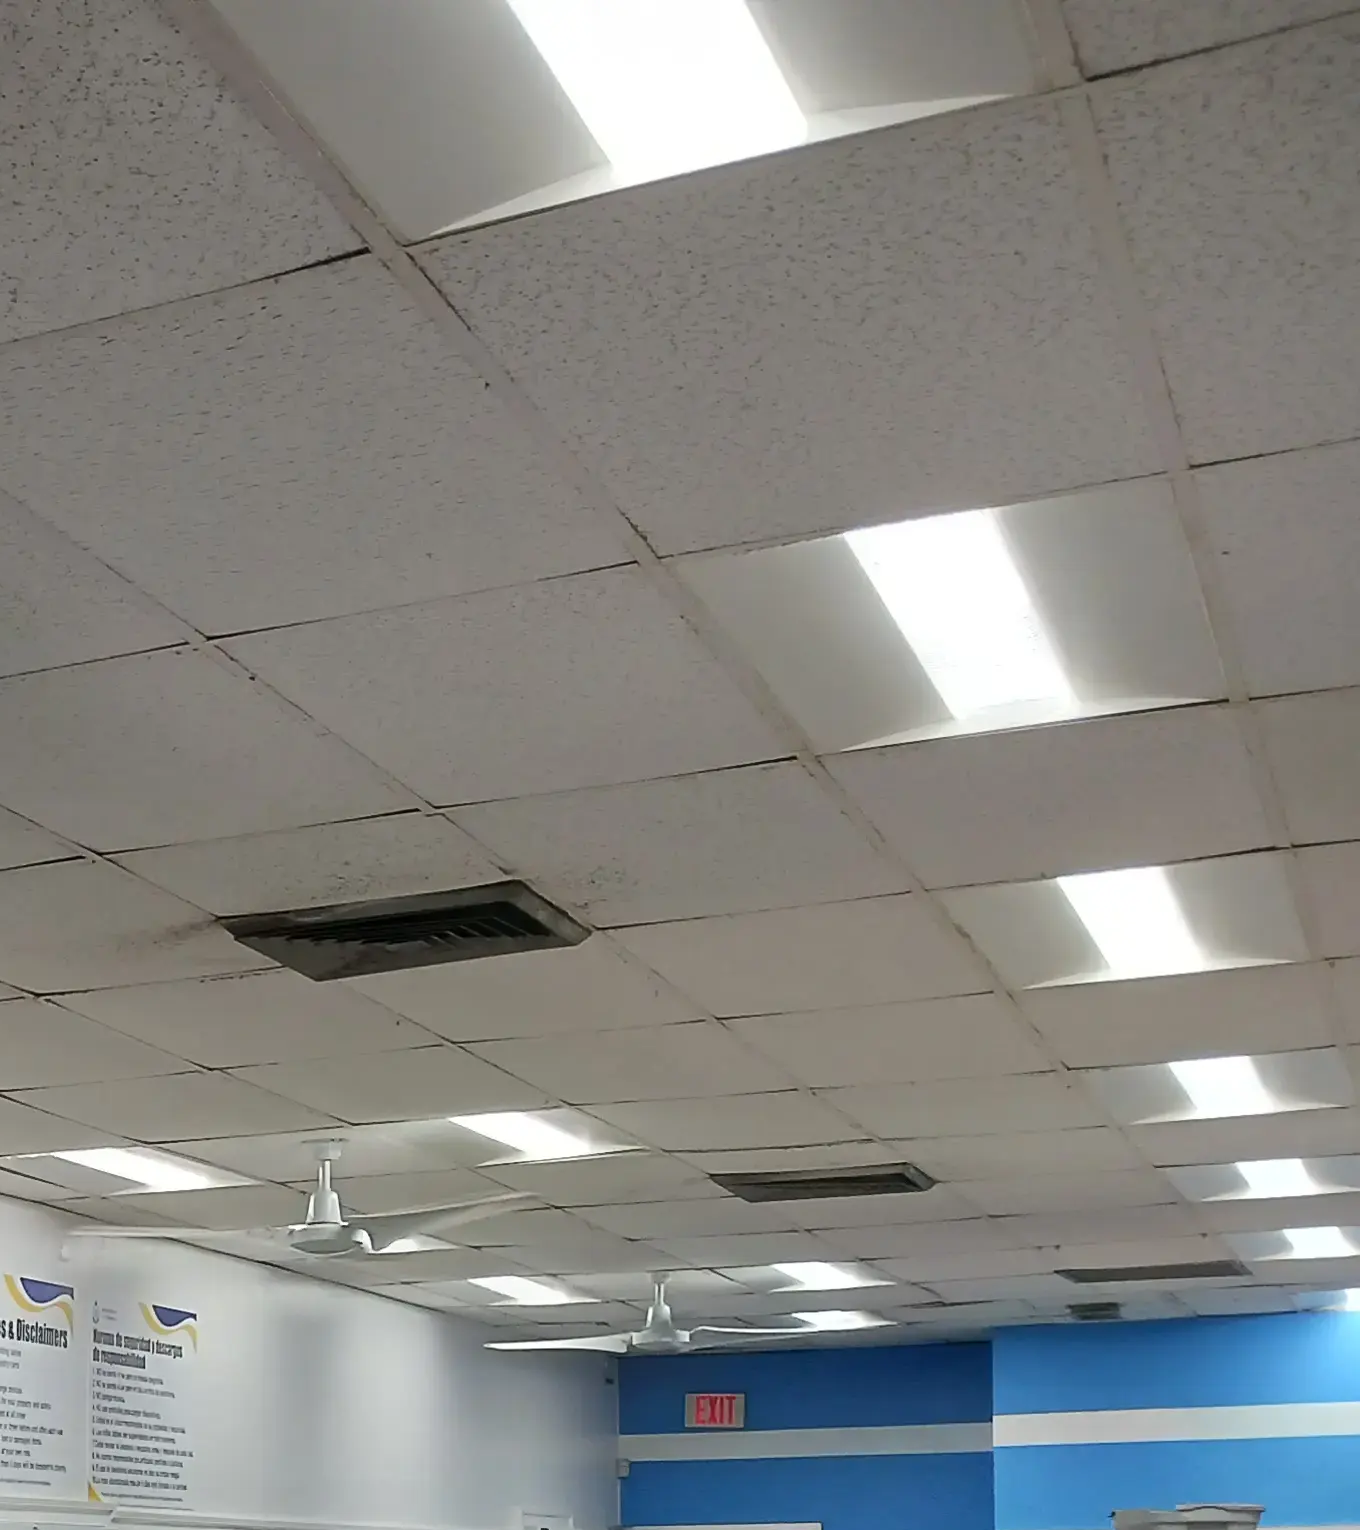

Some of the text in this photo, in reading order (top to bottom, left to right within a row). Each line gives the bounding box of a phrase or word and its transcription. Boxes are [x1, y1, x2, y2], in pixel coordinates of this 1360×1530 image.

[8, 1320, 15, 1340] &
[16, 1318, 68, 1349] Disclaimers
[695, 1395, 737, 1425] EXIT
